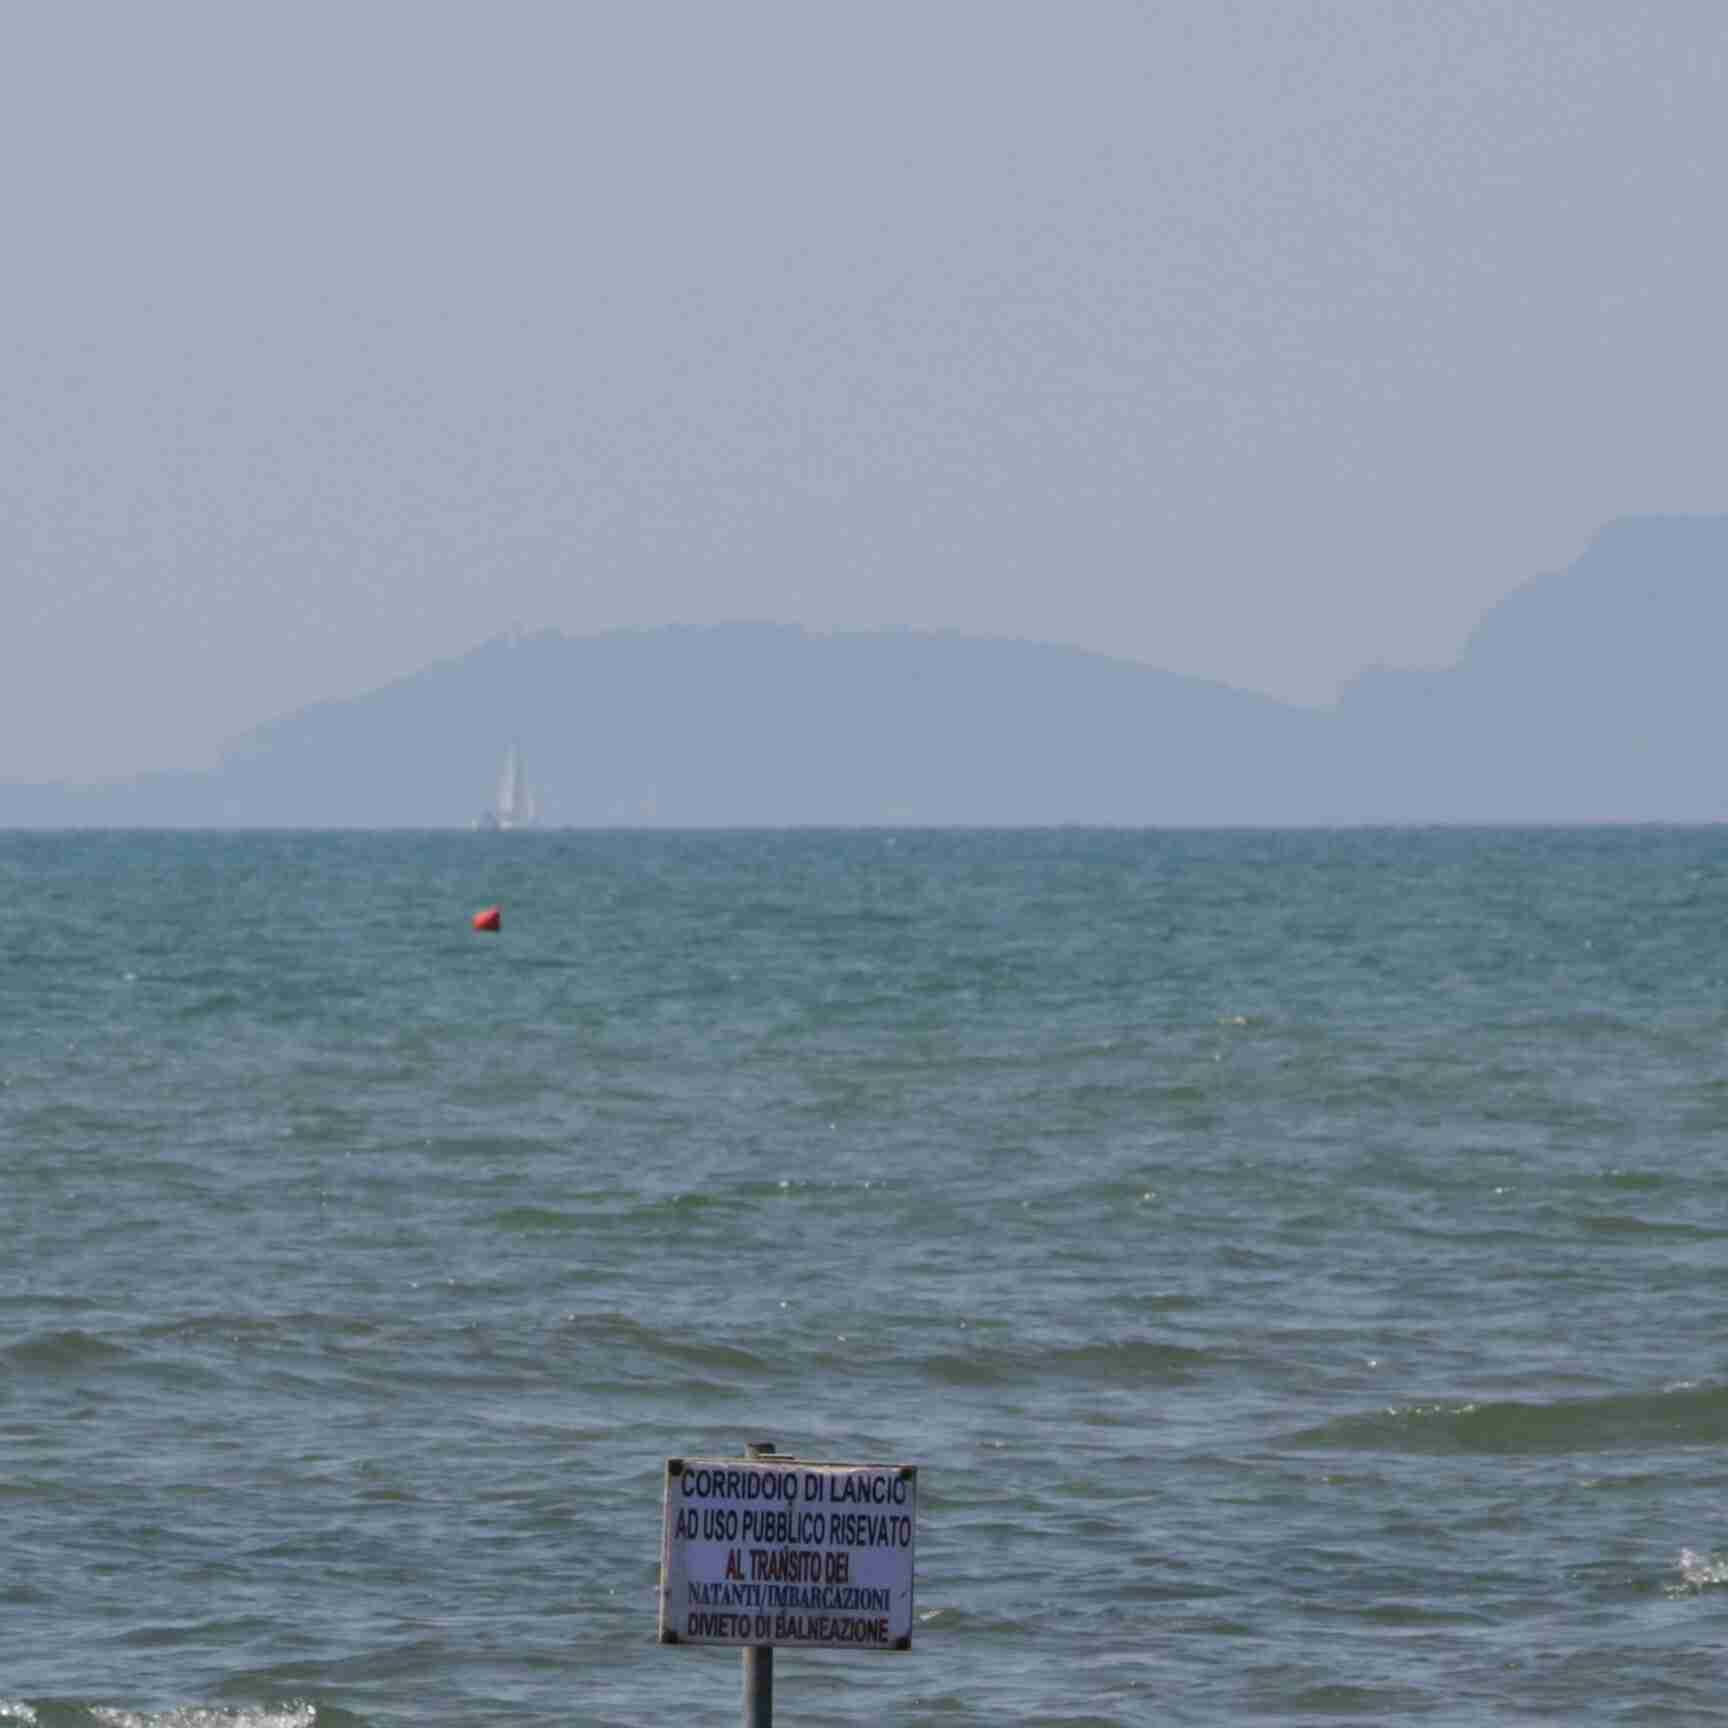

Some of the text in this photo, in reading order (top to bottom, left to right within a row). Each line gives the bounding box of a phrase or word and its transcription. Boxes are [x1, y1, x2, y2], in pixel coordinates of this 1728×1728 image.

[681, 1470, 907, 1504] CORRIDOIO DI LANCIO
[675, 1509, 911, 1547] AD USO PUBBLICO RISEVATO
[726, 1549, 849, 1584] AL TRANSITO DEI
[688, 1583, 890, 1611] NATANTI/IMBARCAZIONI
[688, 1613, 889, 1642] DIVIETO DI BALNEAZIONE
